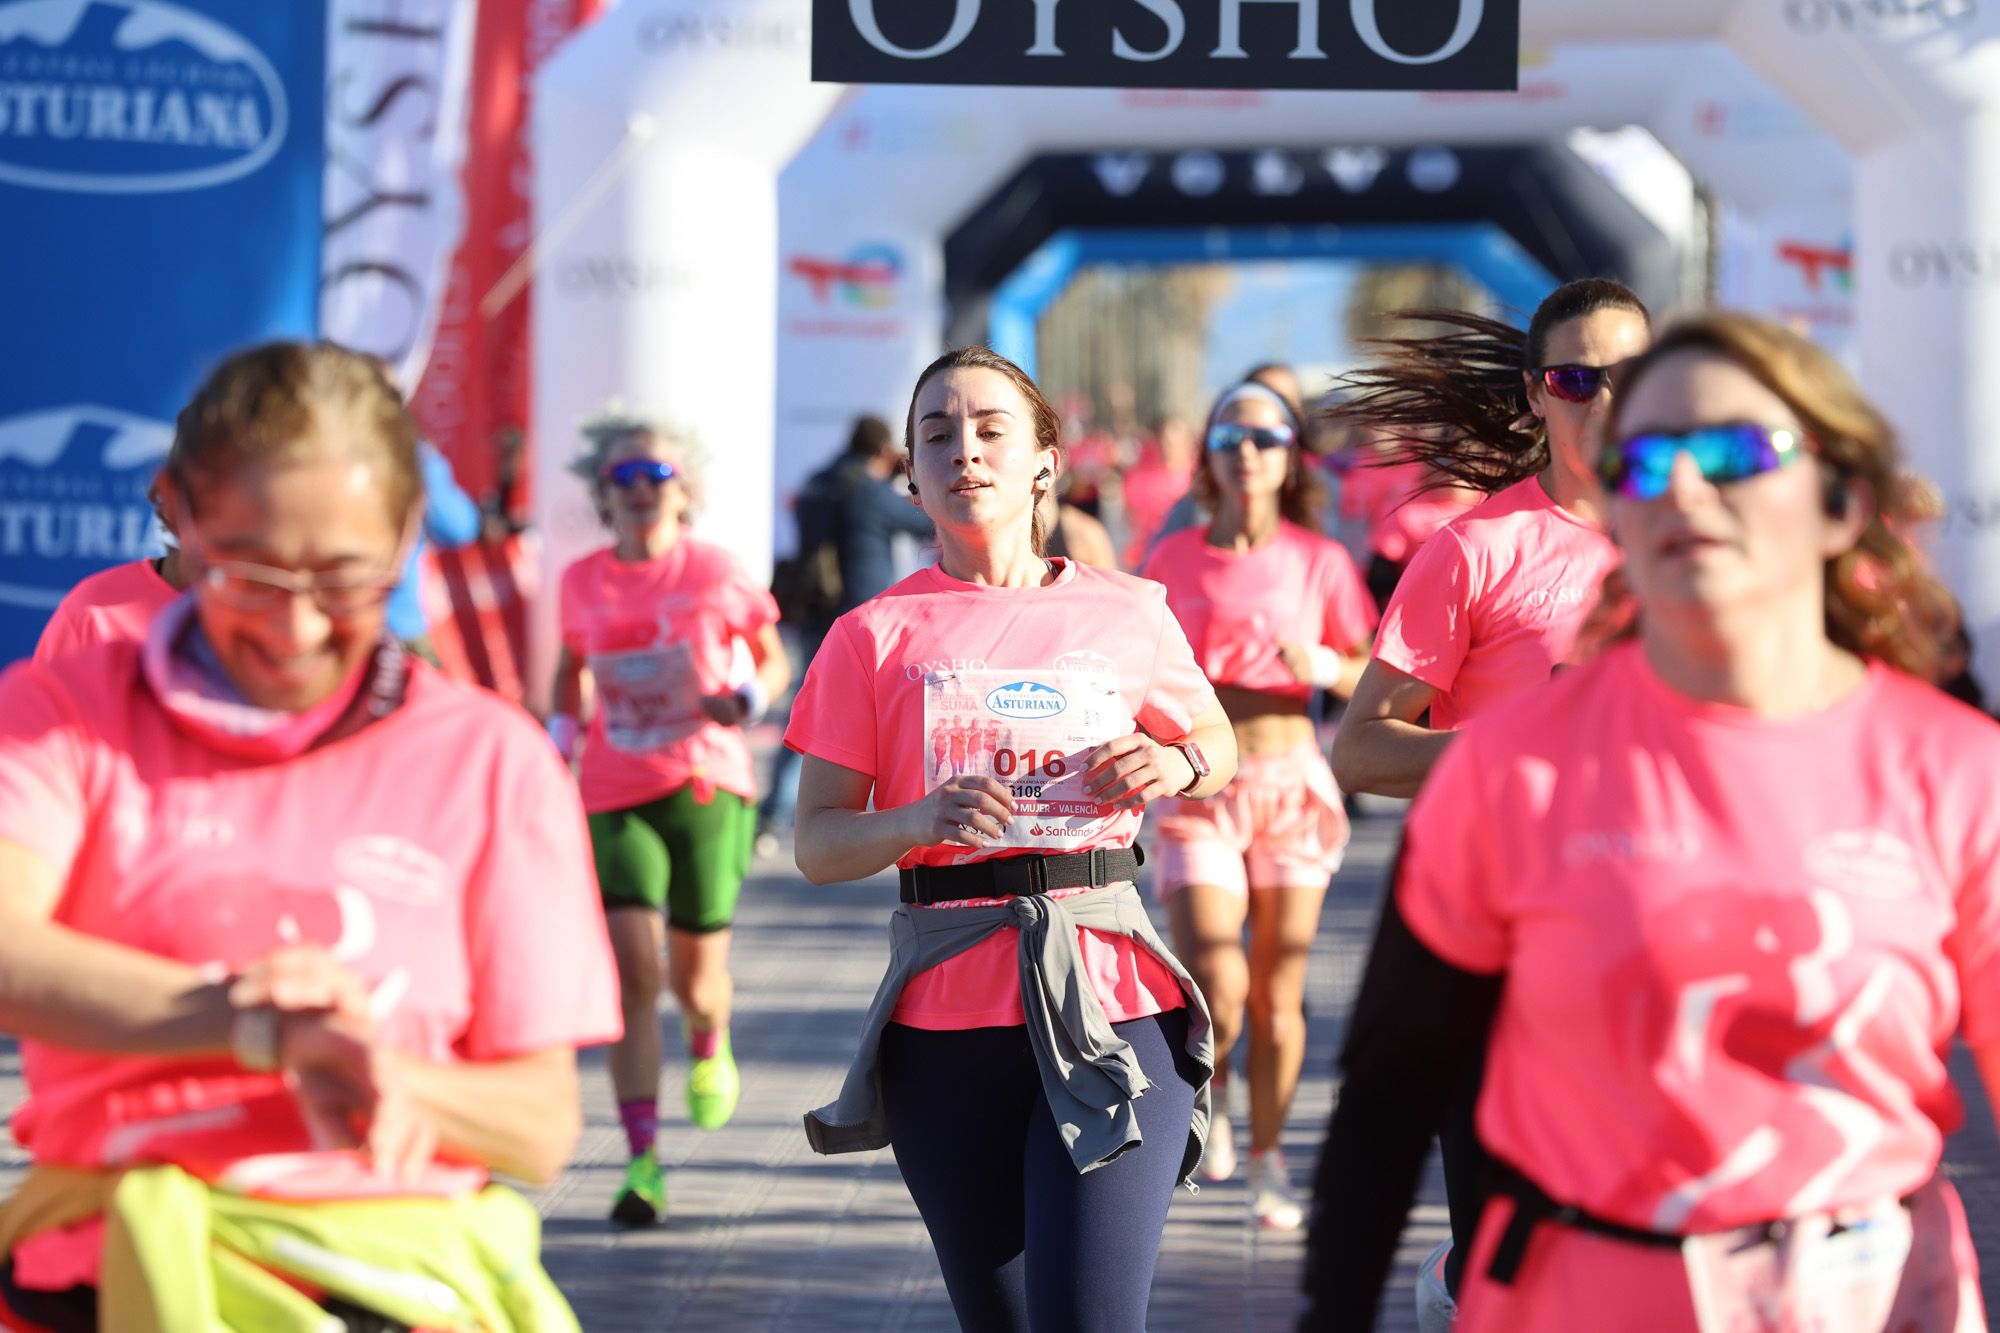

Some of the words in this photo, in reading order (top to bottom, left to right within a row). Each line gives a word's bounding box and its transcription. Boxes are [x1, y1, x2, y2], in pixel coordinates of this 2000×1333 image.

[906, 659, 988, 681] OYSHO
[940, 701, 978, 711] SUMA
[992, 695, 1061, 710] ASTURIANA
[994, 748, 1066, 777] 016
[1020, 803, 1050, 813] MUJER
